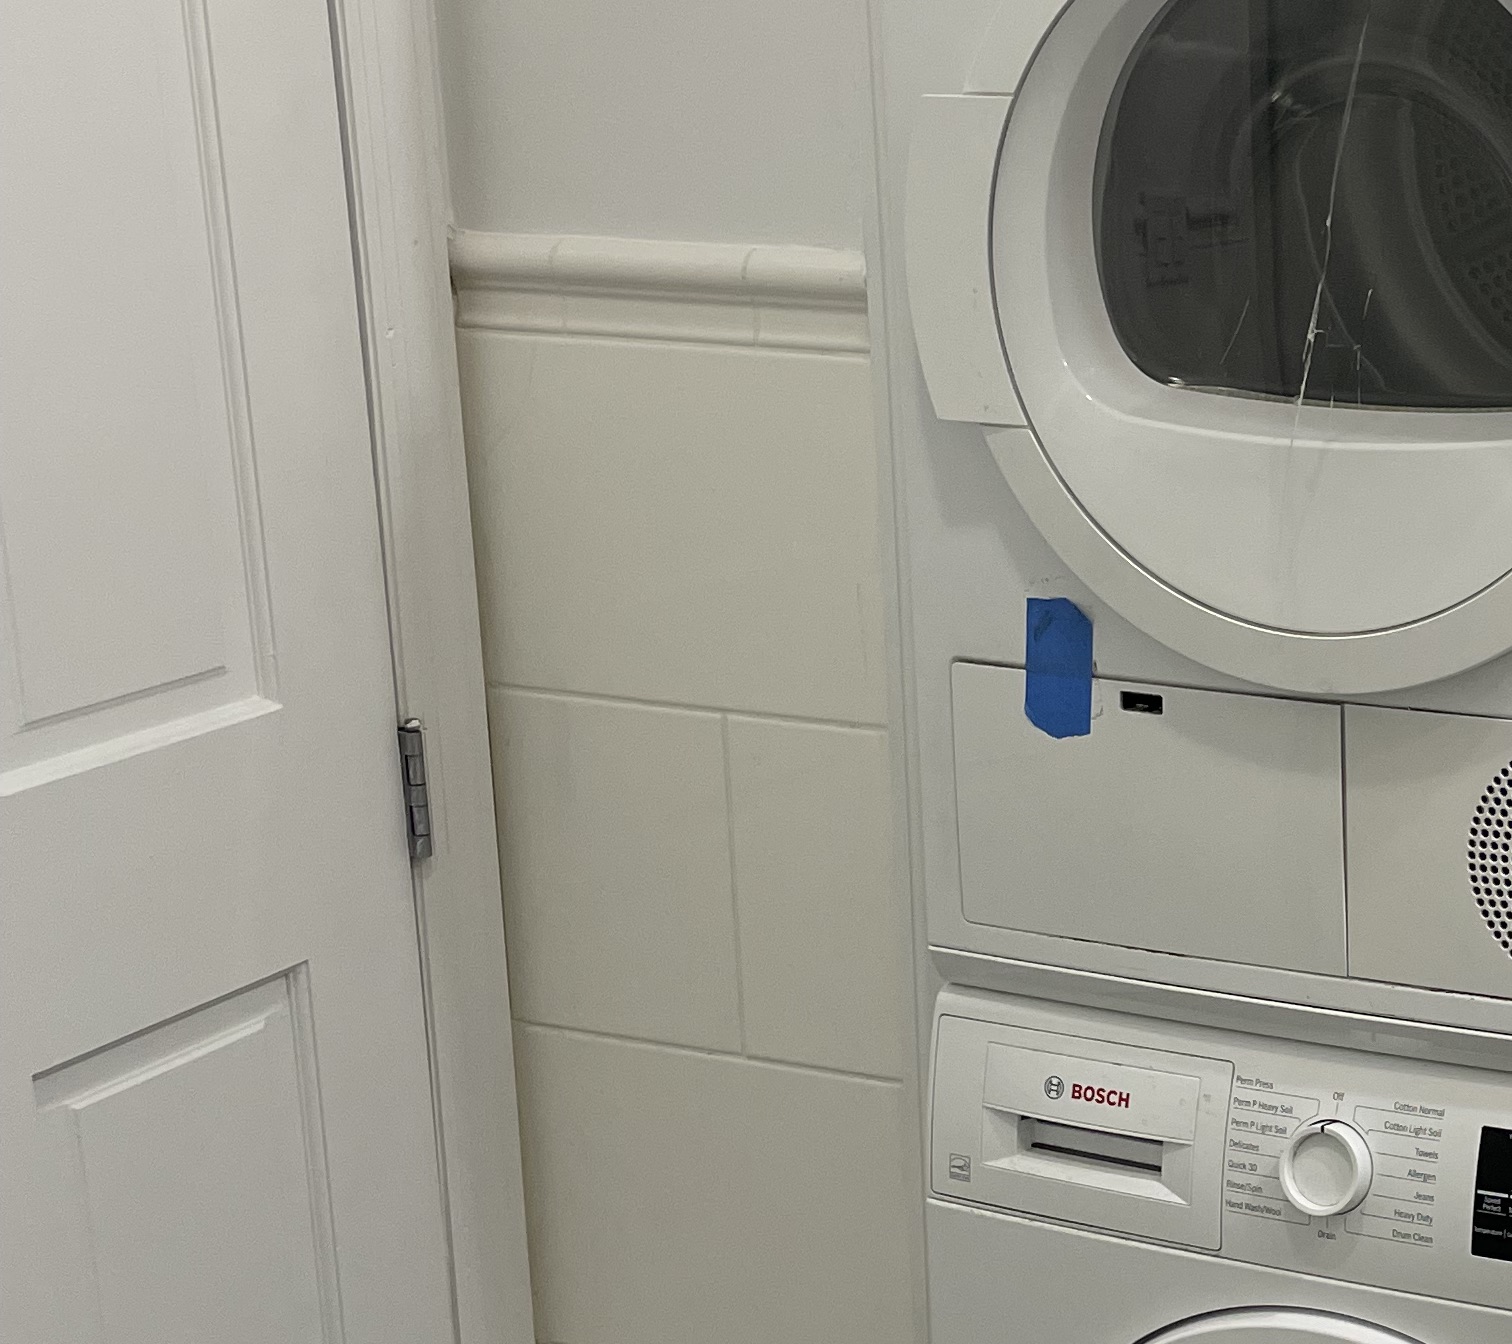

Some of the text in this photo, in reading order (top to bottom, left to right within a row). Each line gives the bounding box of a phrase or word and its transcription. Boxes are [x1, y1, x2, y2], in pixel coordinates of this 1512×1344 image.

[1236, 1075, 1274, 1089] Perm Press
[1072, 1084, 1130, 1108] BOSCH
[1233, 1097, 1251, 1107] Perm
[1258, 1102, 1278, 1114] Heavy
[1280, 1105, 1293, 1114] Soil
[1394, 1102, 1445, 1116] Cotton Normal
[1231, 1118, 1249, 1128] Perm
[1275, 1125, 1287, 1134] Soil
[1384, 1121, 1408, 1132] Cotton
[1428, 1127, 1442, 1138] Soil
[1229, 1139, 1259, 1151] Delicates
[1415, 1147, 1439, 1159] Towels
[1228, 1160, 1246, 1170] Quick
[1407, 1169, 1436, 1182] Allergen
[1225, 1199, 1243, 1209] Hand
[1414, 1192, 1434, 1202] Jeans
[1394, 1209, 1433, 1224] Heavy Duty
[1318, 1230, 1336, 1240] Drain
[1392, 1229, 1433, 1243] Drum Clean
